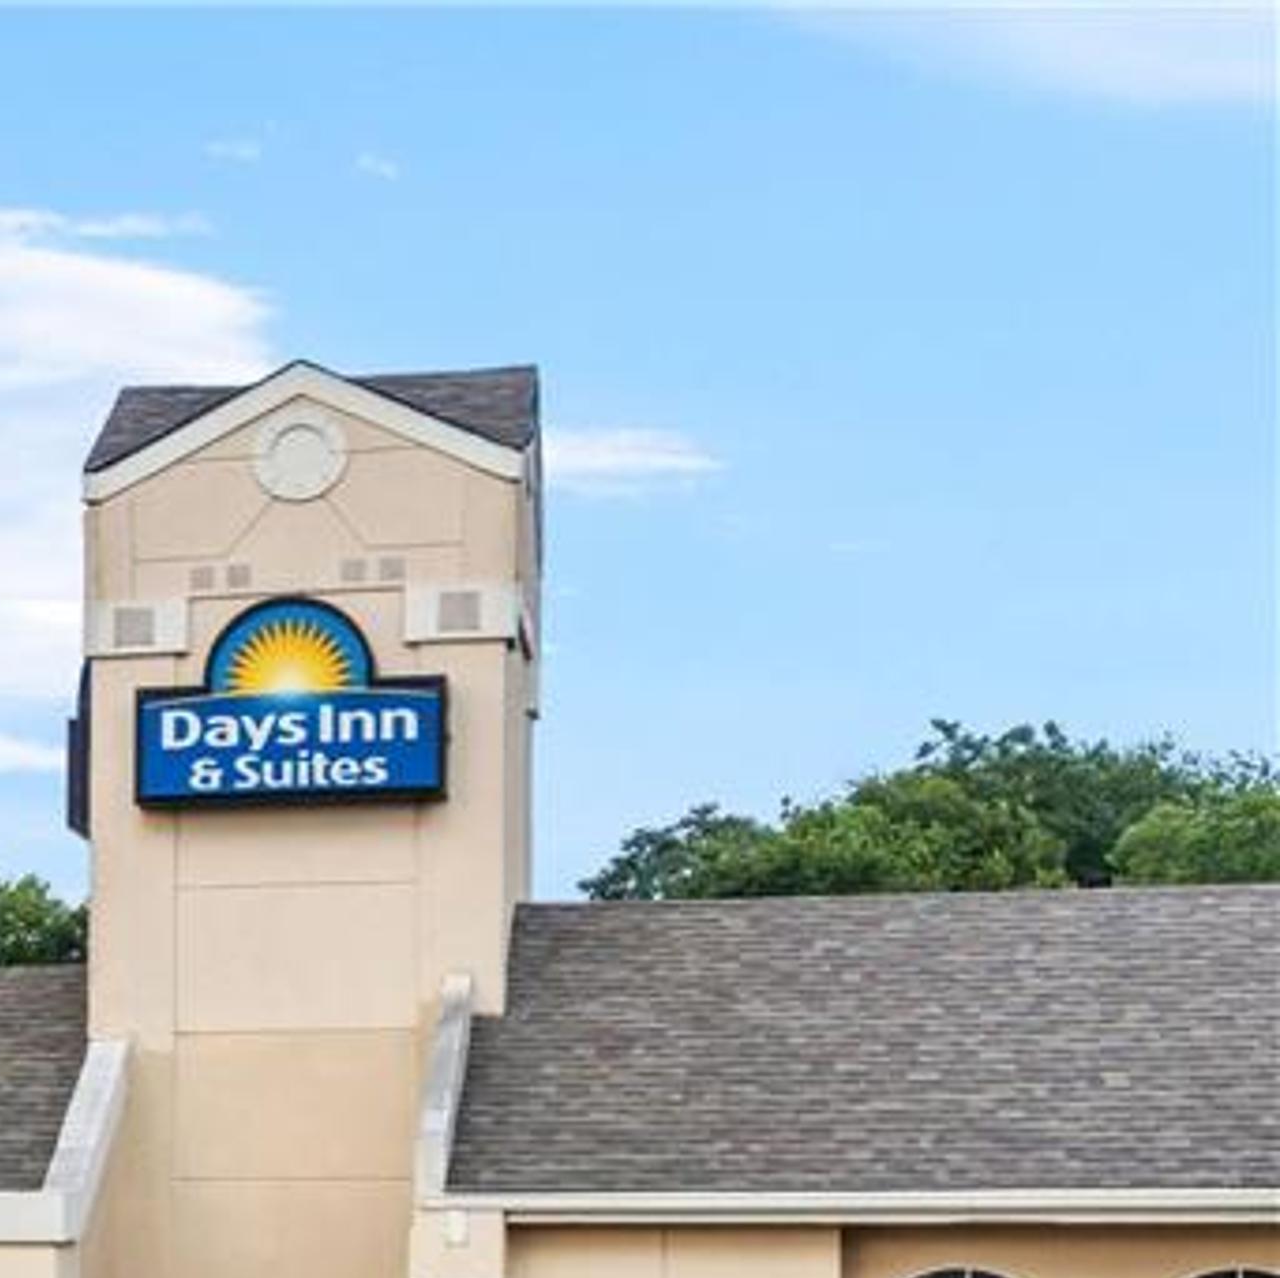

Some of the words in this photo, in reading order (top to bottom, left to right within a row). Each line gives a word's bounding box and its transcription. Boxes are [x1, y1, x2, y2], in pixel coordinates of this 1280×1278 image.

[160, 709, 308, 751] Days
[318, 703, 419, 743] Inn
[189, 757, 224, 790] &
[233, 750, 389, 789] Suites
